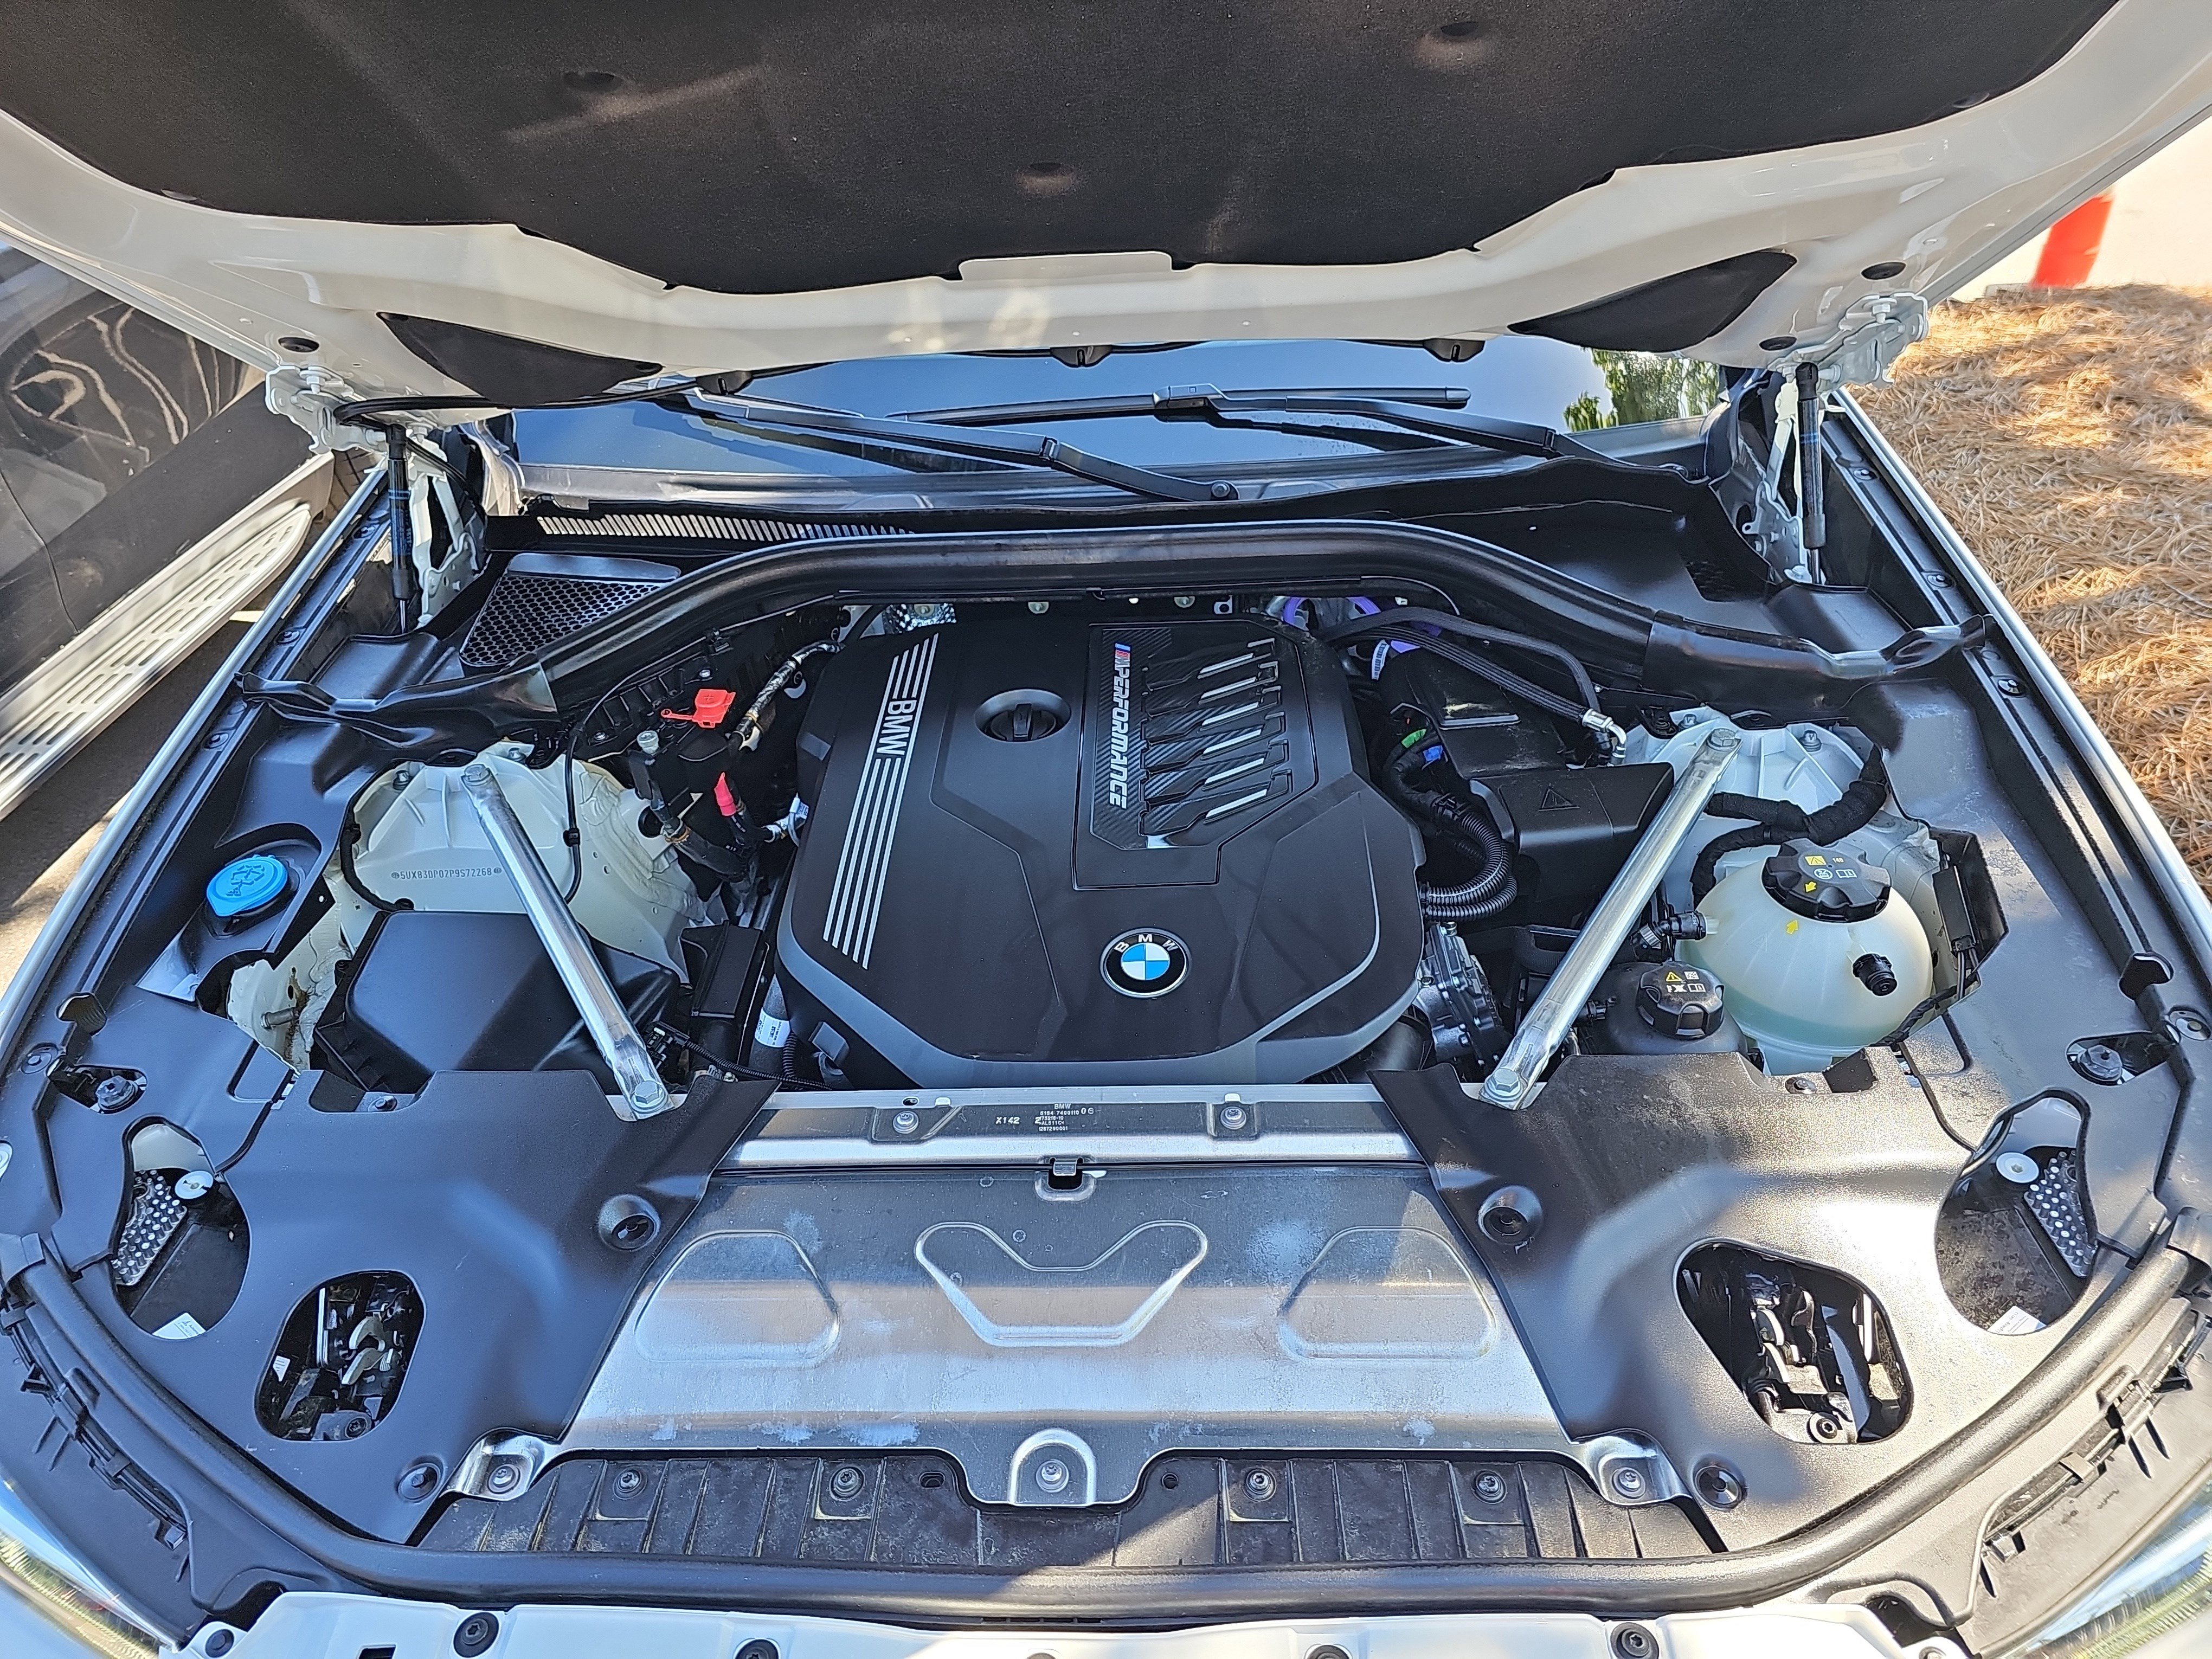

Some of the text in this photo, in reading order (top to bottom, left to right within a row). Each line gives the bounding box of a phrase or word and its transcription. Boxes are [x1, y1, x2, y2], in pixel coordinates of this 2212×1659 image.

[876, 699, 917, 755] BMW
[1109, 666, 1130, 809] PERFORMANCE
[401, 868, 492, 879] 5UX83DP02P9S72268
[1114, 934, 1179, 953] BMW
[995, 1116, 1020, 1124] X142
